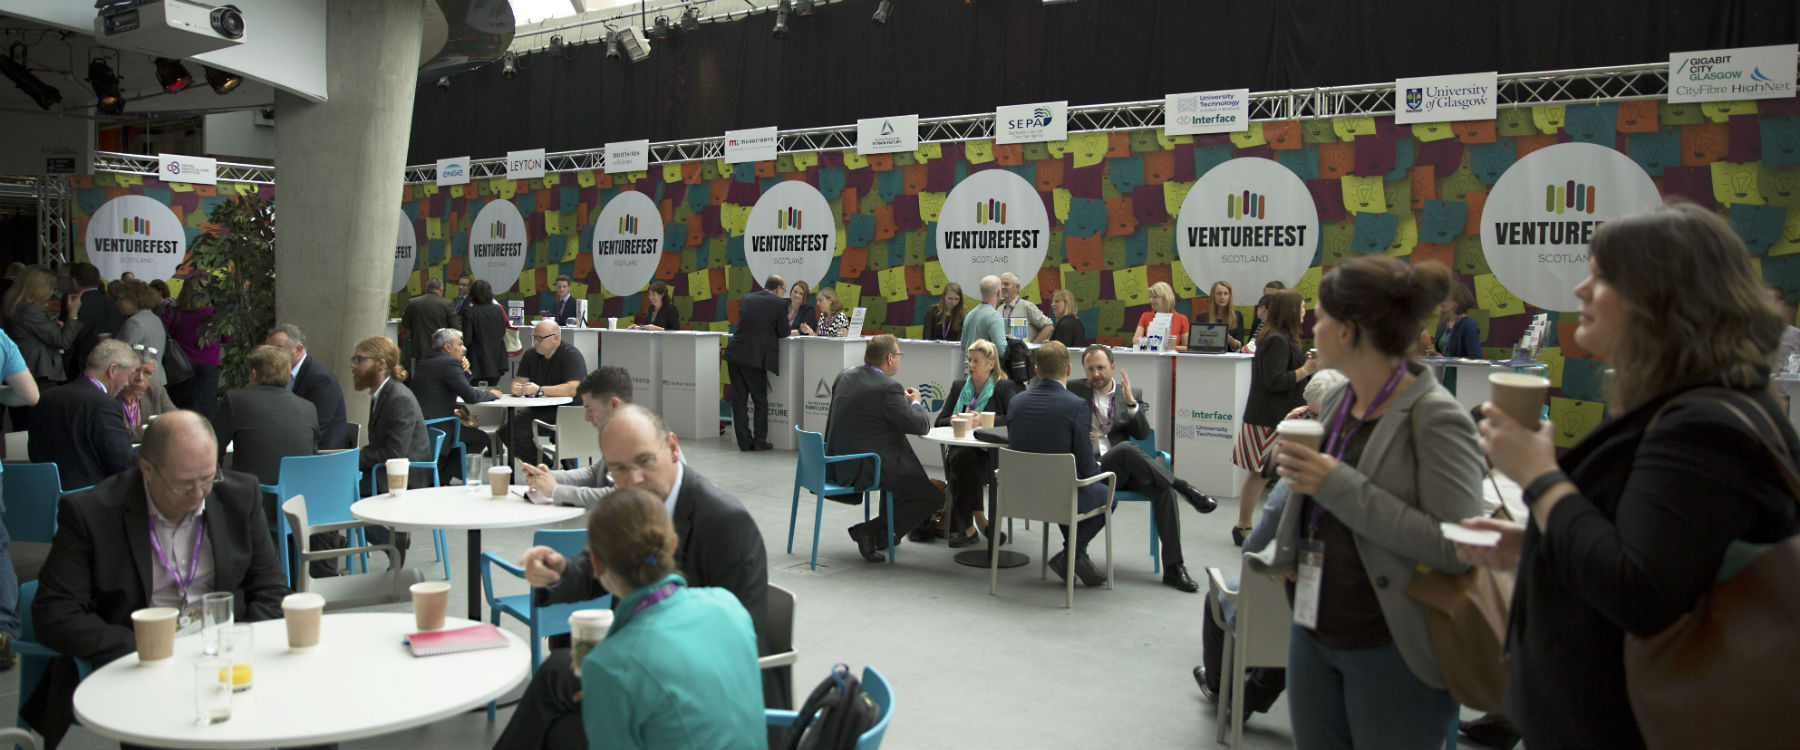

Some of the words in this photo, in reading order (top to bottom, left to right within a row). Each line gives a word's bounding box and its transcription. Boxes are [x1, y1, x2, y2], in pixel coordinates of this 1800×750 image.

[1690, 55, 1732, 66] GIGABIT
[1689, 65, 1714, 74] CITY
[1689, 71, 1743, 81] GLASGOW
[1426, 83, 1489, 98] University
[1676, 84, 1728, 97] CityFibre
[1731, 81, 1792, 94] HighNet
[1200, 93, 1235, 101] University
[1200, 100, 1240, 108] Technology
[1425, 97, 1438, 112] of
[1437, 96, 1489, 110] Glasgow
[1008, 118, 1044, 130] SEPA
[1192, 113, 1236, 125] Interface
[510, 158, 542, 172] LEYTON
[1187, 225, 1307, 248] VENTUREFEST
[1495, 221, 1606, 245] VENTURE
[94, 237, 179, 254] VENTUREFEST
[752, 234, 829, 252] VENTUREFEST
[944, 229, 1040, 250] VENTUREFEST
[473, 242, 523, 258] VENTUREFEST
[598, 238, 659, 255] VENTUREFEST
[773, 257, 805, 265] SCOTLAND
[971, 255, 1009, 264] SCOTLAND
[1221, 255, 1269, 264] SCOTLAND
[1538, 254, 1592, 263] SCOTLAN
[1191, 410, 1233, 421] Interface
[1195, 425, 1228, 433] University
[1195, 431, 1233, 440] Technology
